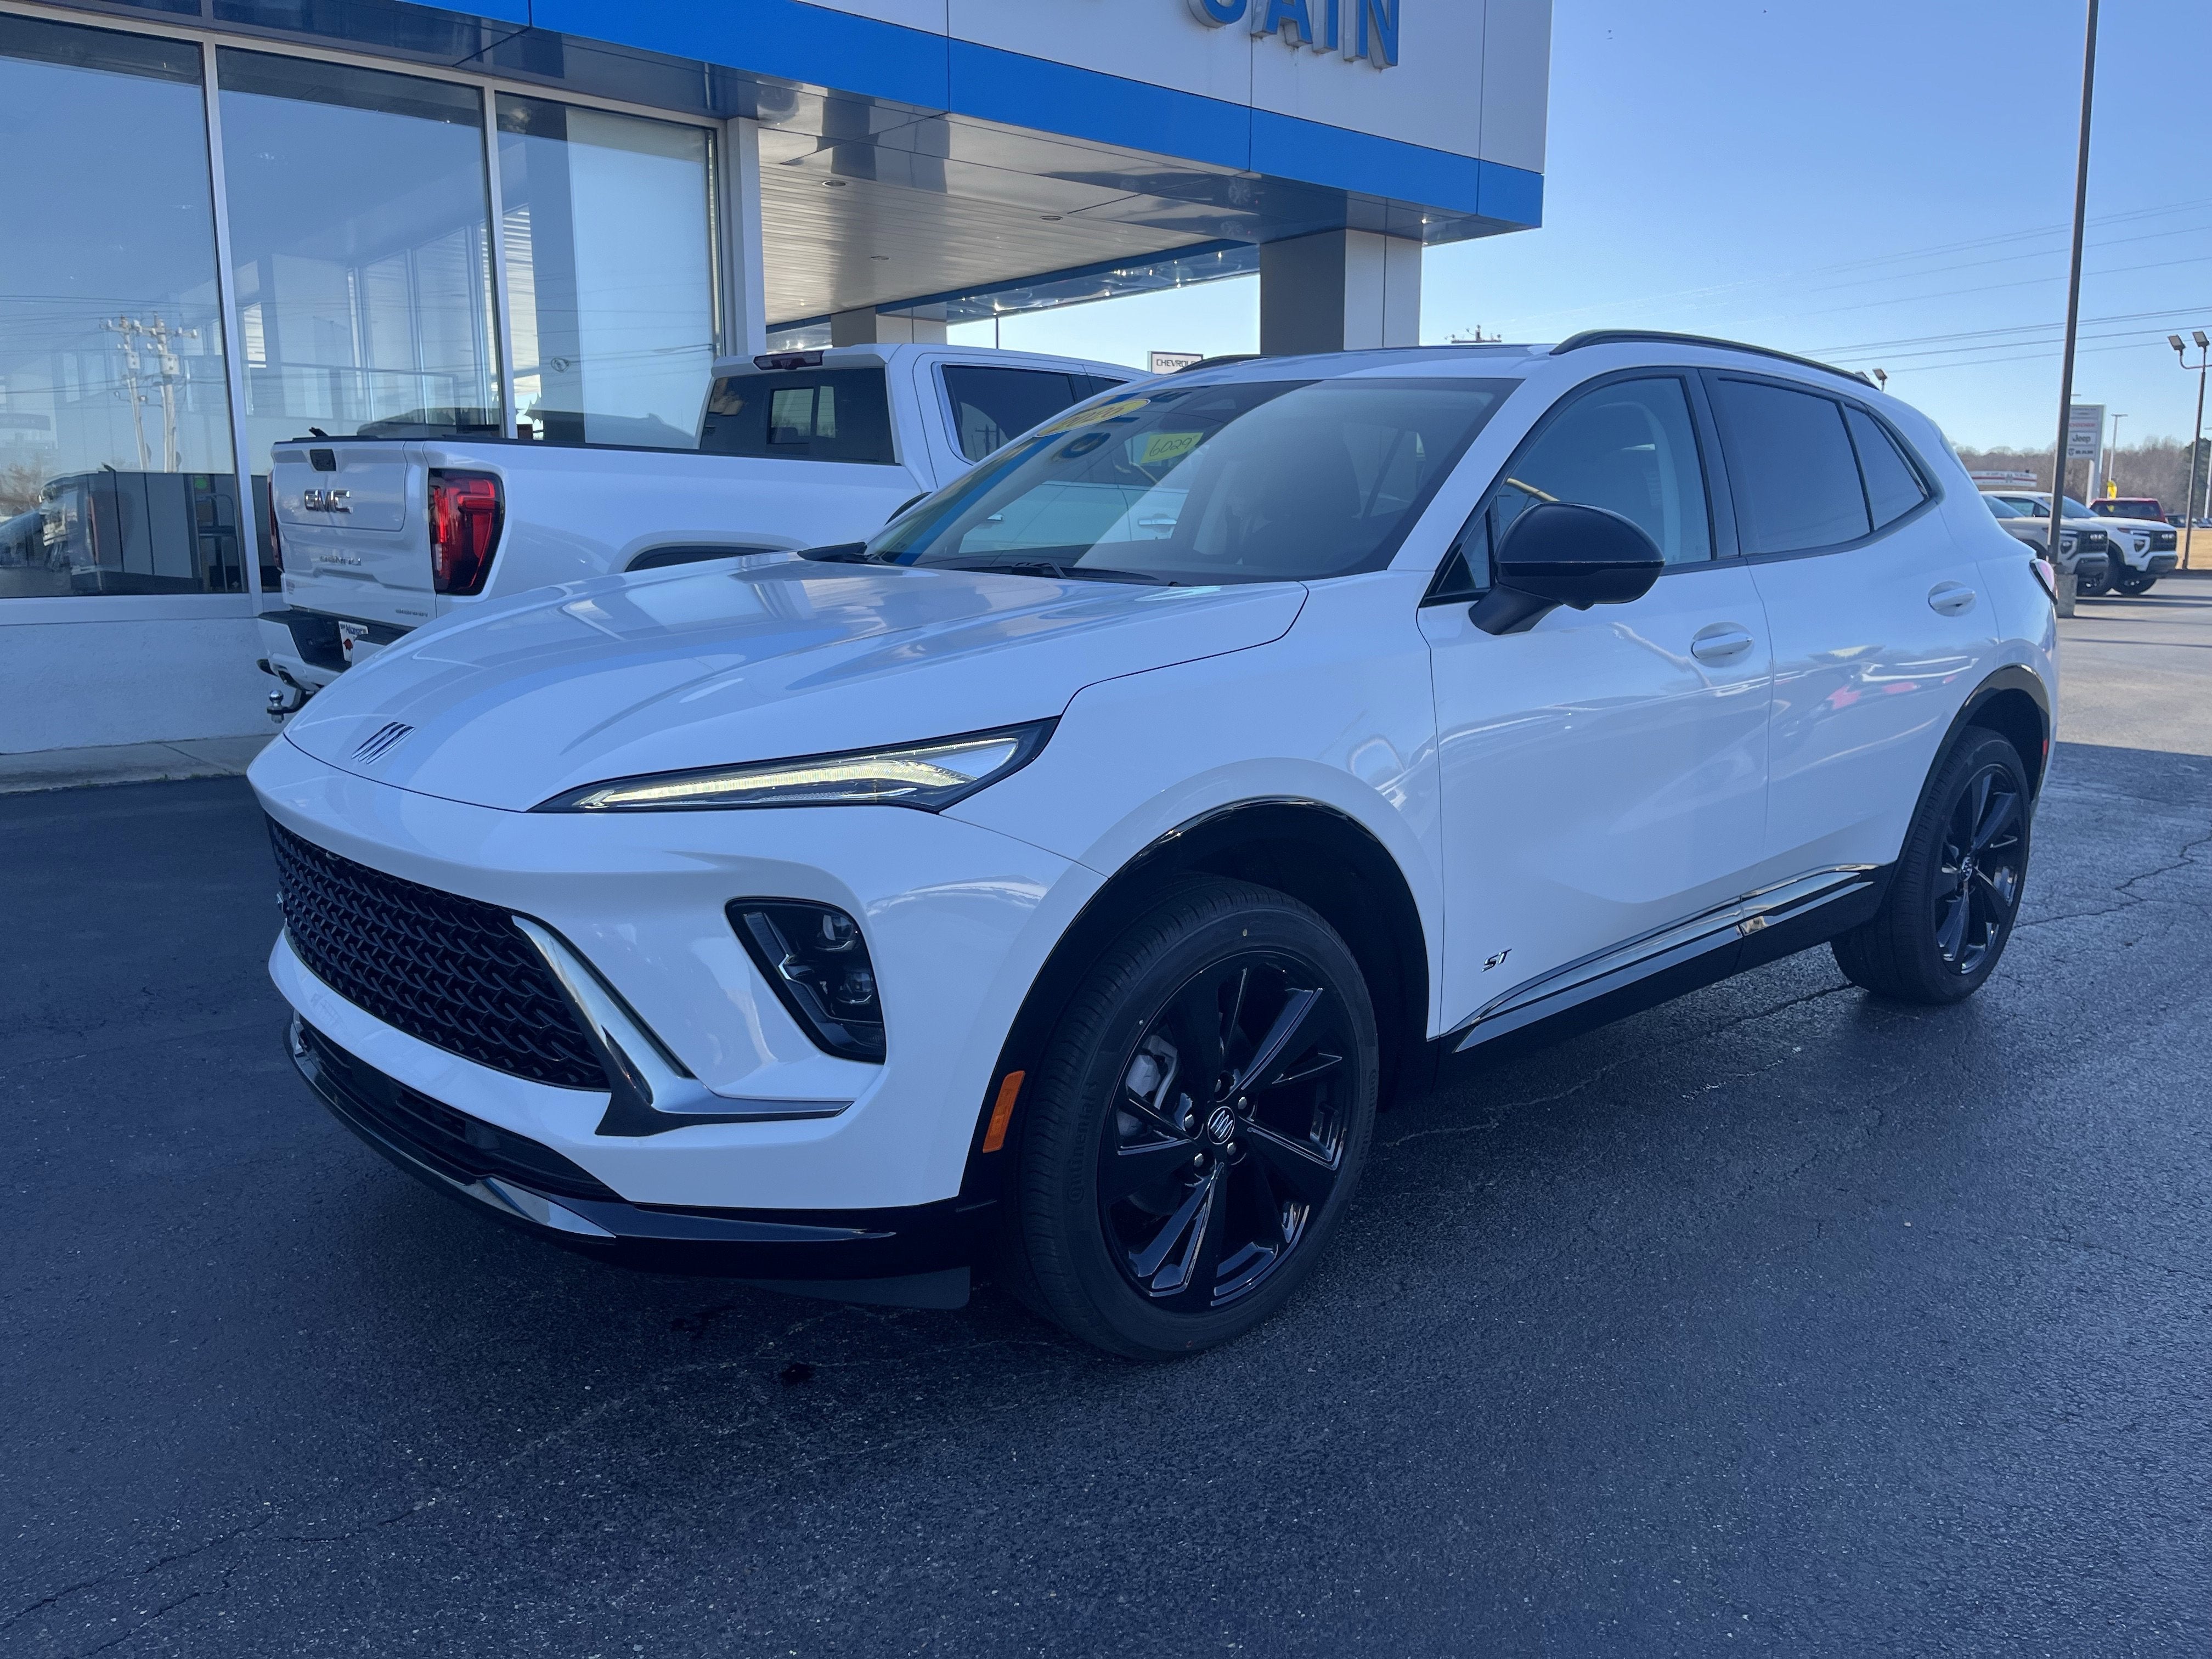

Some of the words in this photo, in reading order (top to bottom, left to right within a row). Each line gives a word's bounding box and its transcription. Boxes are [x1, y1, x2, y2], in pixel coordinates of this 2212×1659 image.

[1149, 437, 1193, 457] 6029
[2072, 434, 2091, 444] Jeep
[304, 489, 353, 514] GMC
[1480, 948, 1513, 973] ST
[1068, 1094, 1097, 1206] Continental
